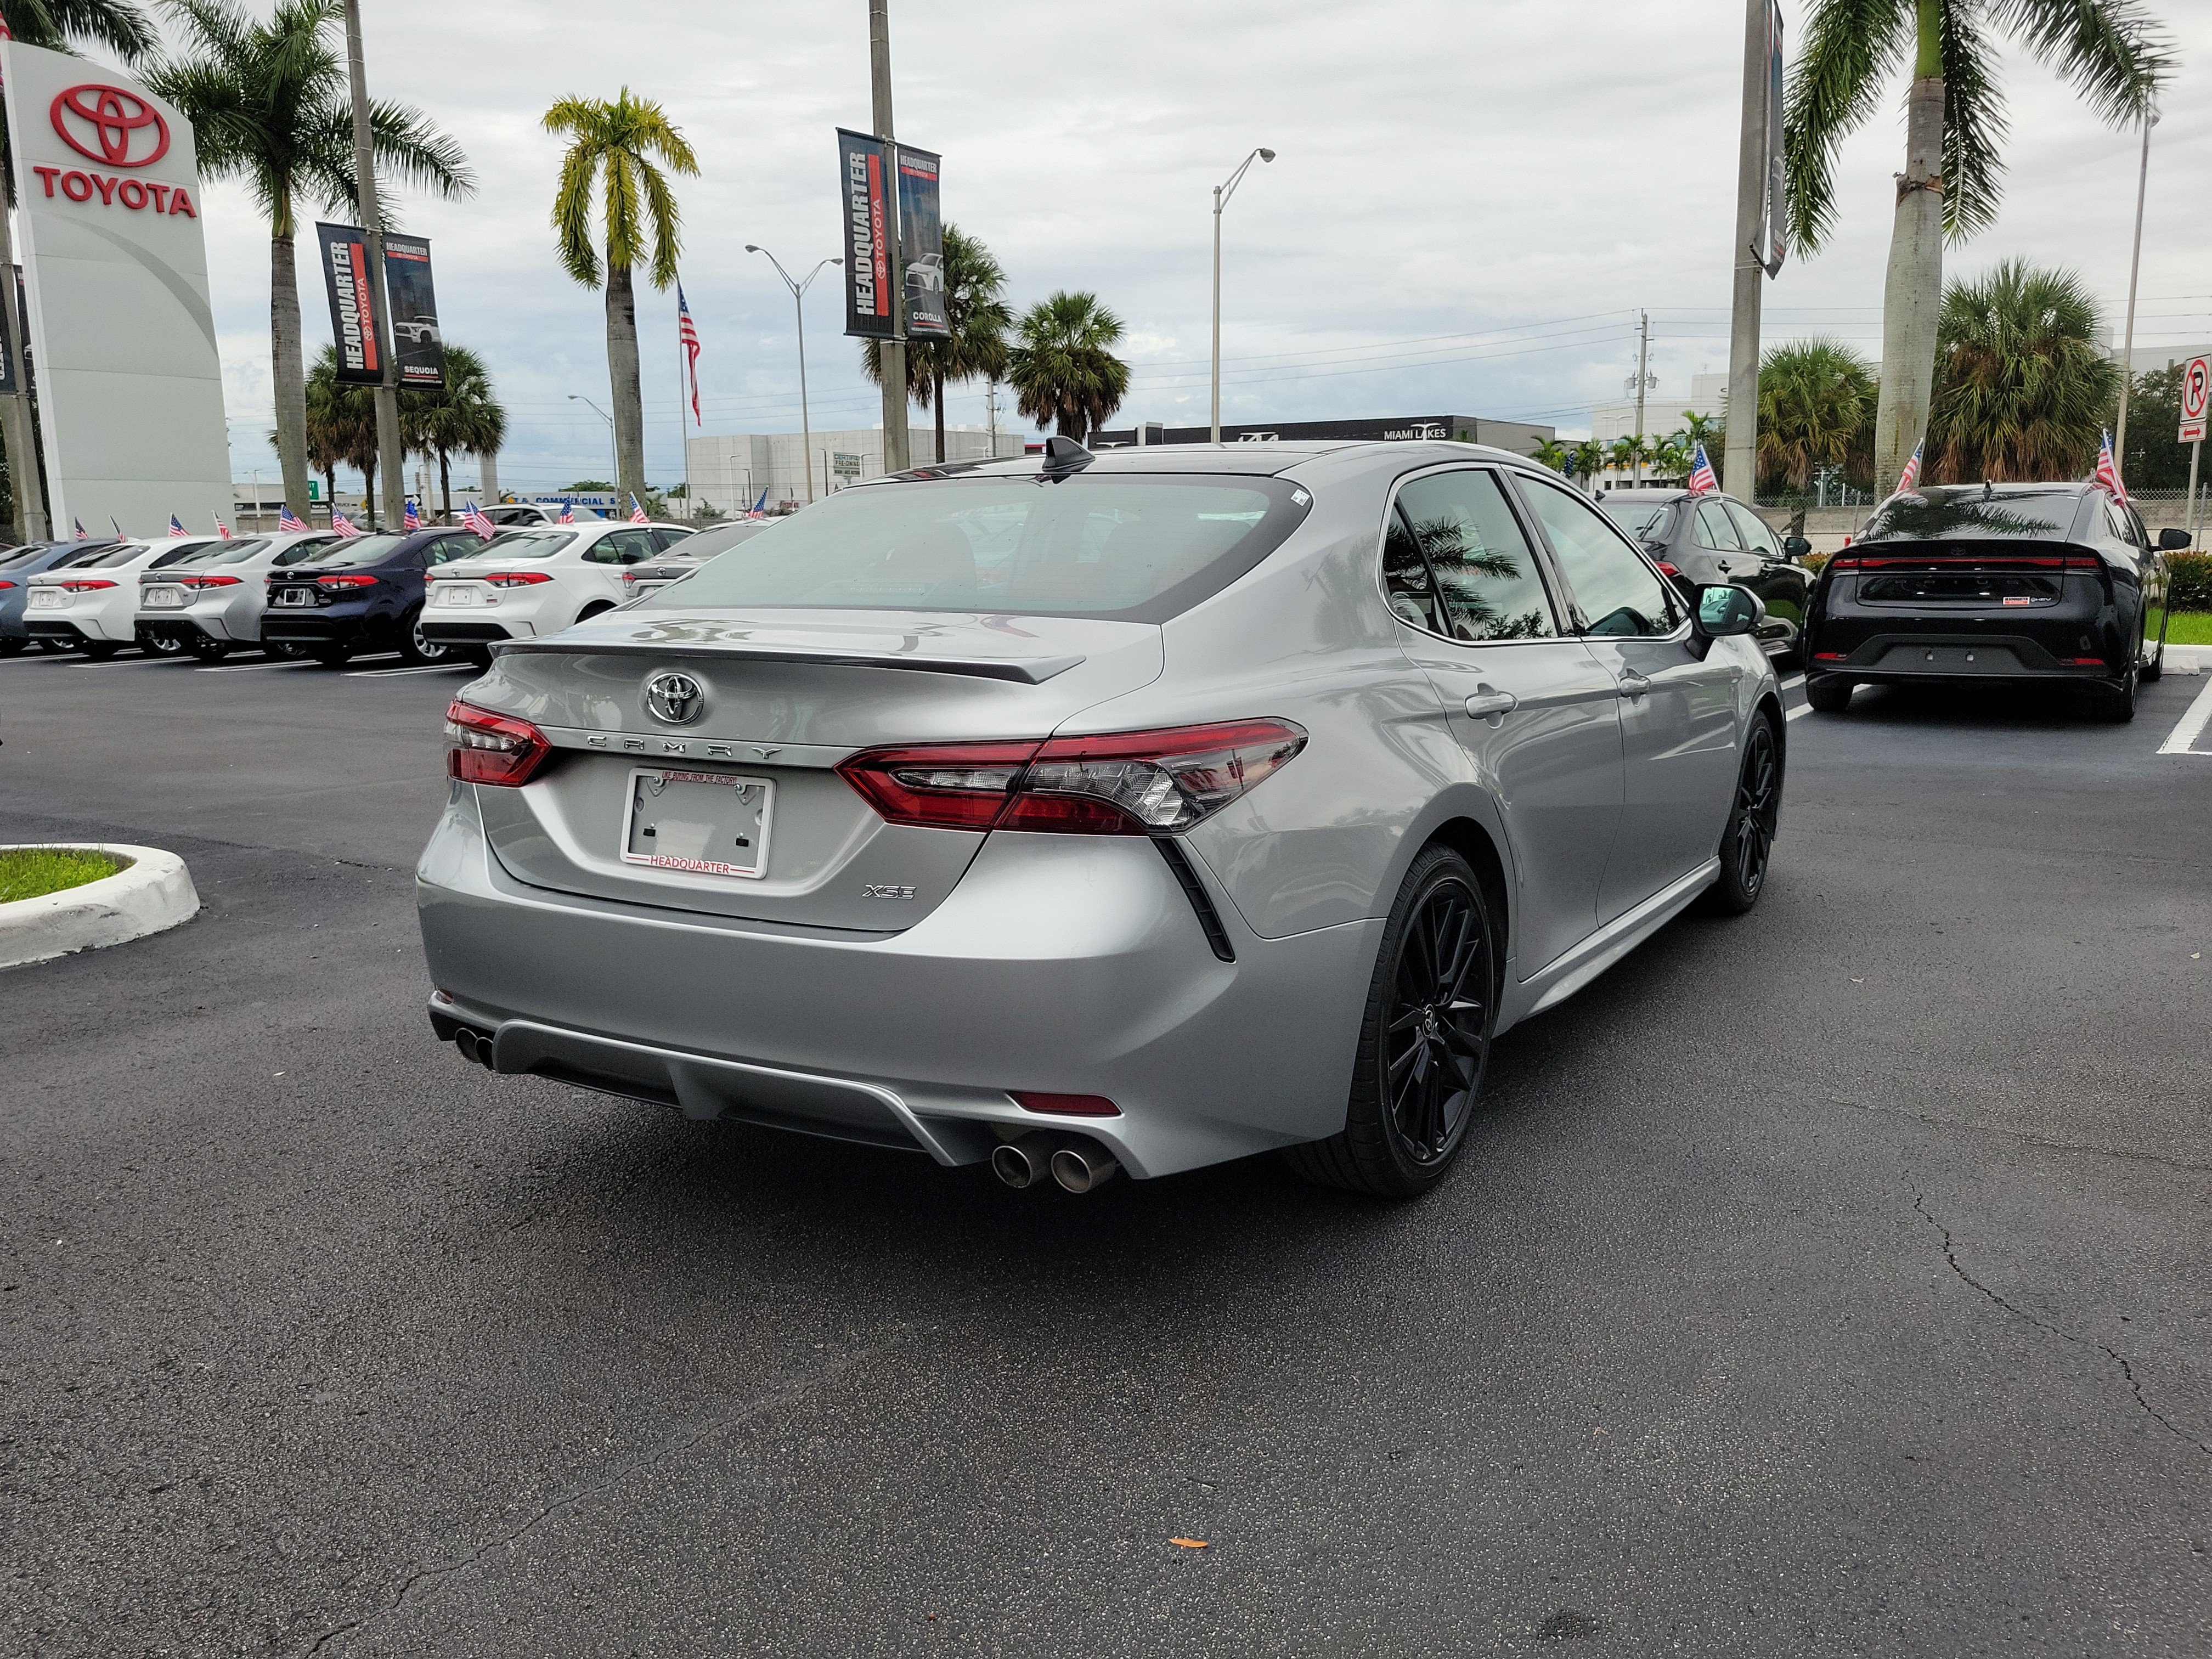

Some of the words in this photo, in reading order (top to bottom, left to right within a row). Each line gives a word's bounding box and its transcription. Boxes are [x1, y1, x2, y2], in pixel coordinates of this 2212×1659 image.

[900, 154, 937, 173] HEADQUARTER
[33, 166, 198, 218] TOYOTA
[850, 153, 874, 315] HEADQUARTER
[872, 199, 884, 258] TOYOTA
[386, 242, 428, 256] HEADQUARTER
[330, 241, 364, 370] HEADQUARTER
[357, 277, 374, 324] TOYOTA
[913, 312, 943, 323] COROLLA
[404, 365, 438, 375] SEQUOIA
[1384, 430, 1414, 440] MIAMI
[587, 736, 782, 759] CAMRY
[673, 772, 689, 780] BUYING
[691, 774, 704, 782] FROM
[706, 775, 714, 783] THE
[651, 855, 730, 874] HEADQUARTER
[862, 884, 917, 899] XSE
